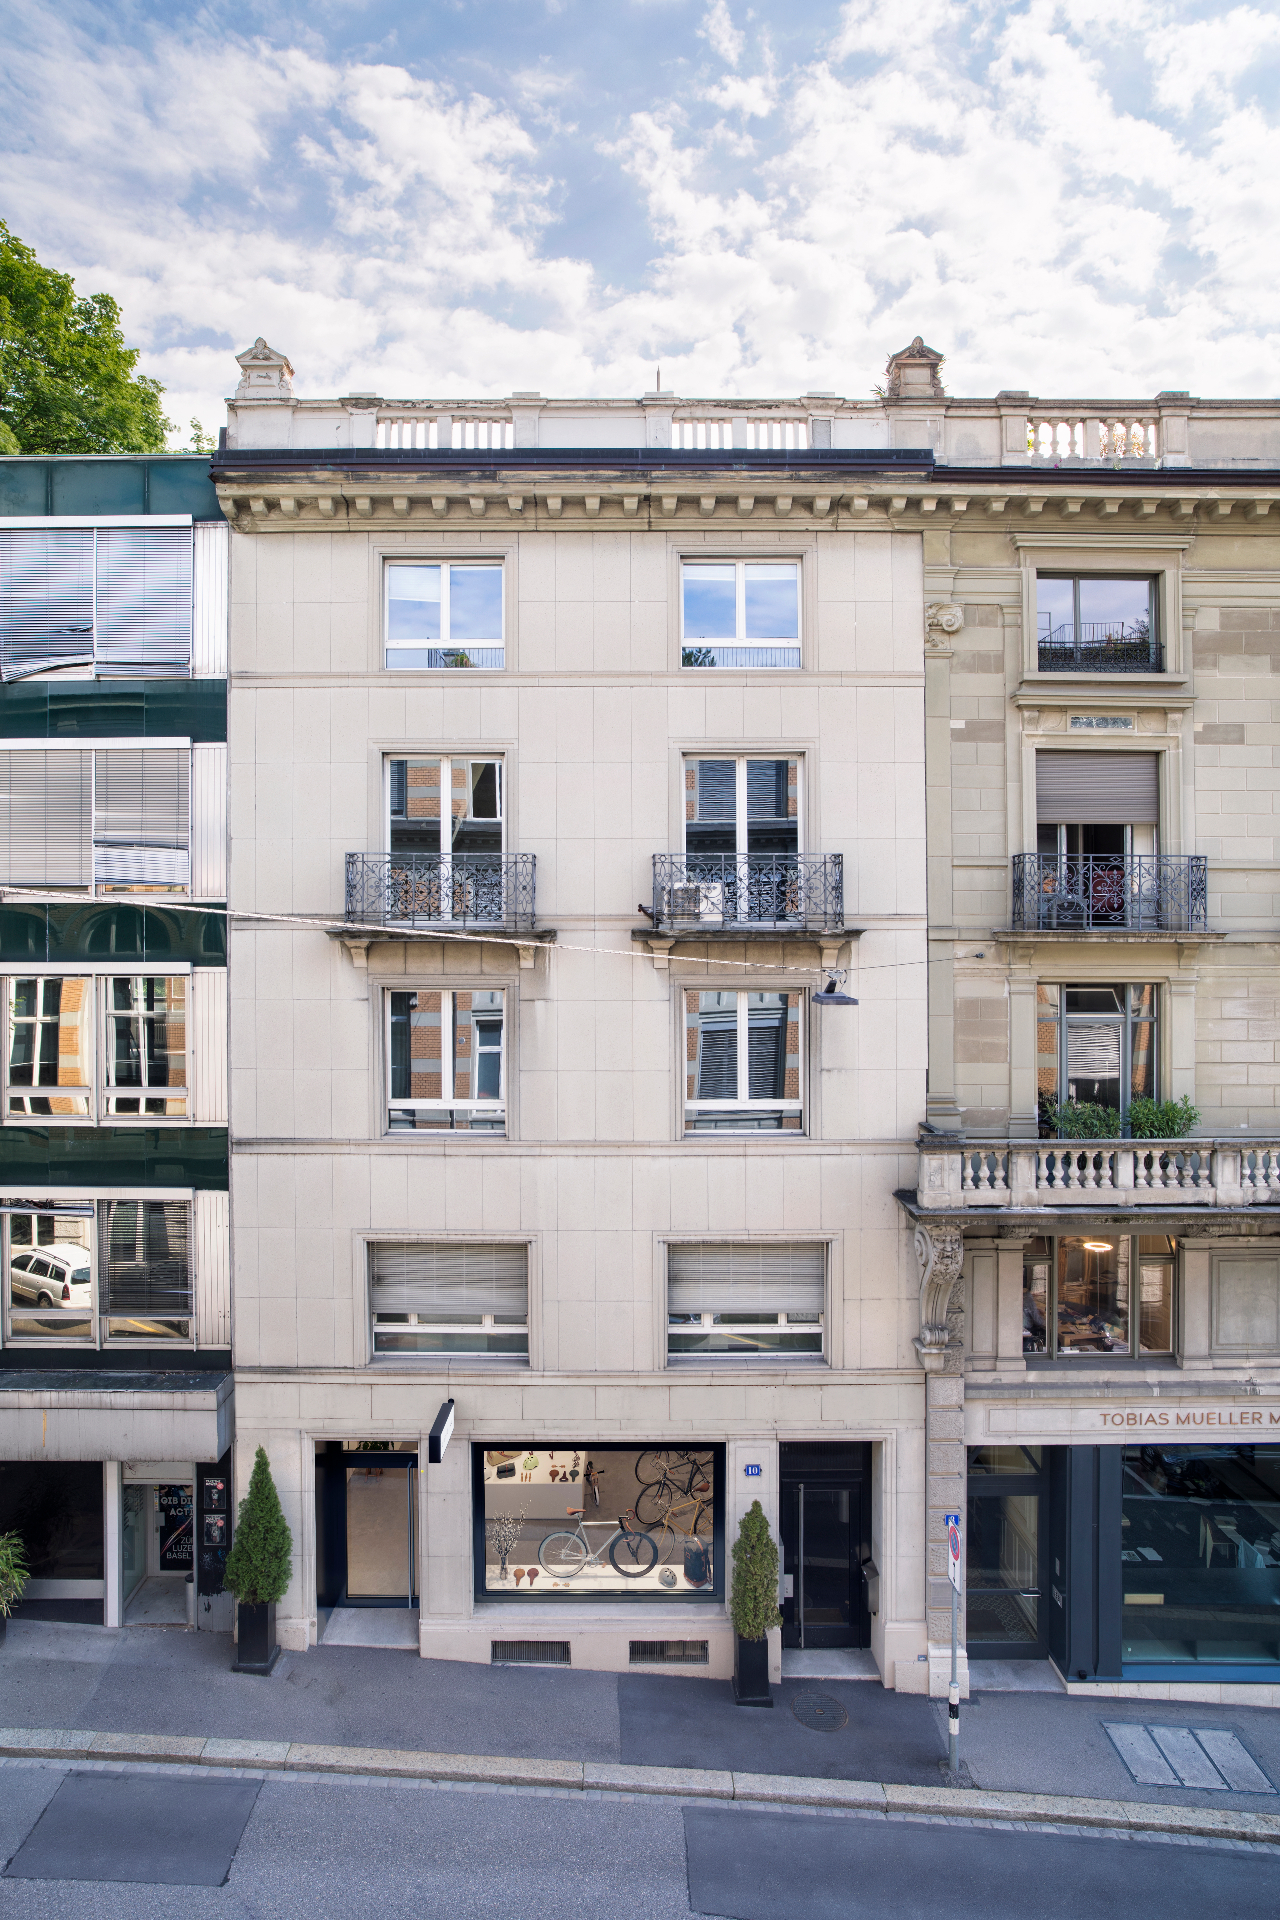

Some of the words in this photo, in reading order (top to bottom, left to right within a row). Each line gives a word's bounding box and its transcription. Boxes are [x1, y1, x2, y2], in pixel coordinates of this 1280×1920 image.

[1099, 1412, 1170, 1426] TOBIAS
[1176, 1411, 1263, 1425] MUELLER
[748, 1466, 758, 1475] 10
[160, 1496, 179, 1505] GIB
[180, 1496, 194, 1505] DI
[172, 1544, 194, 1552] LUZE
[166, 1551, 192, 1559] BASEL
